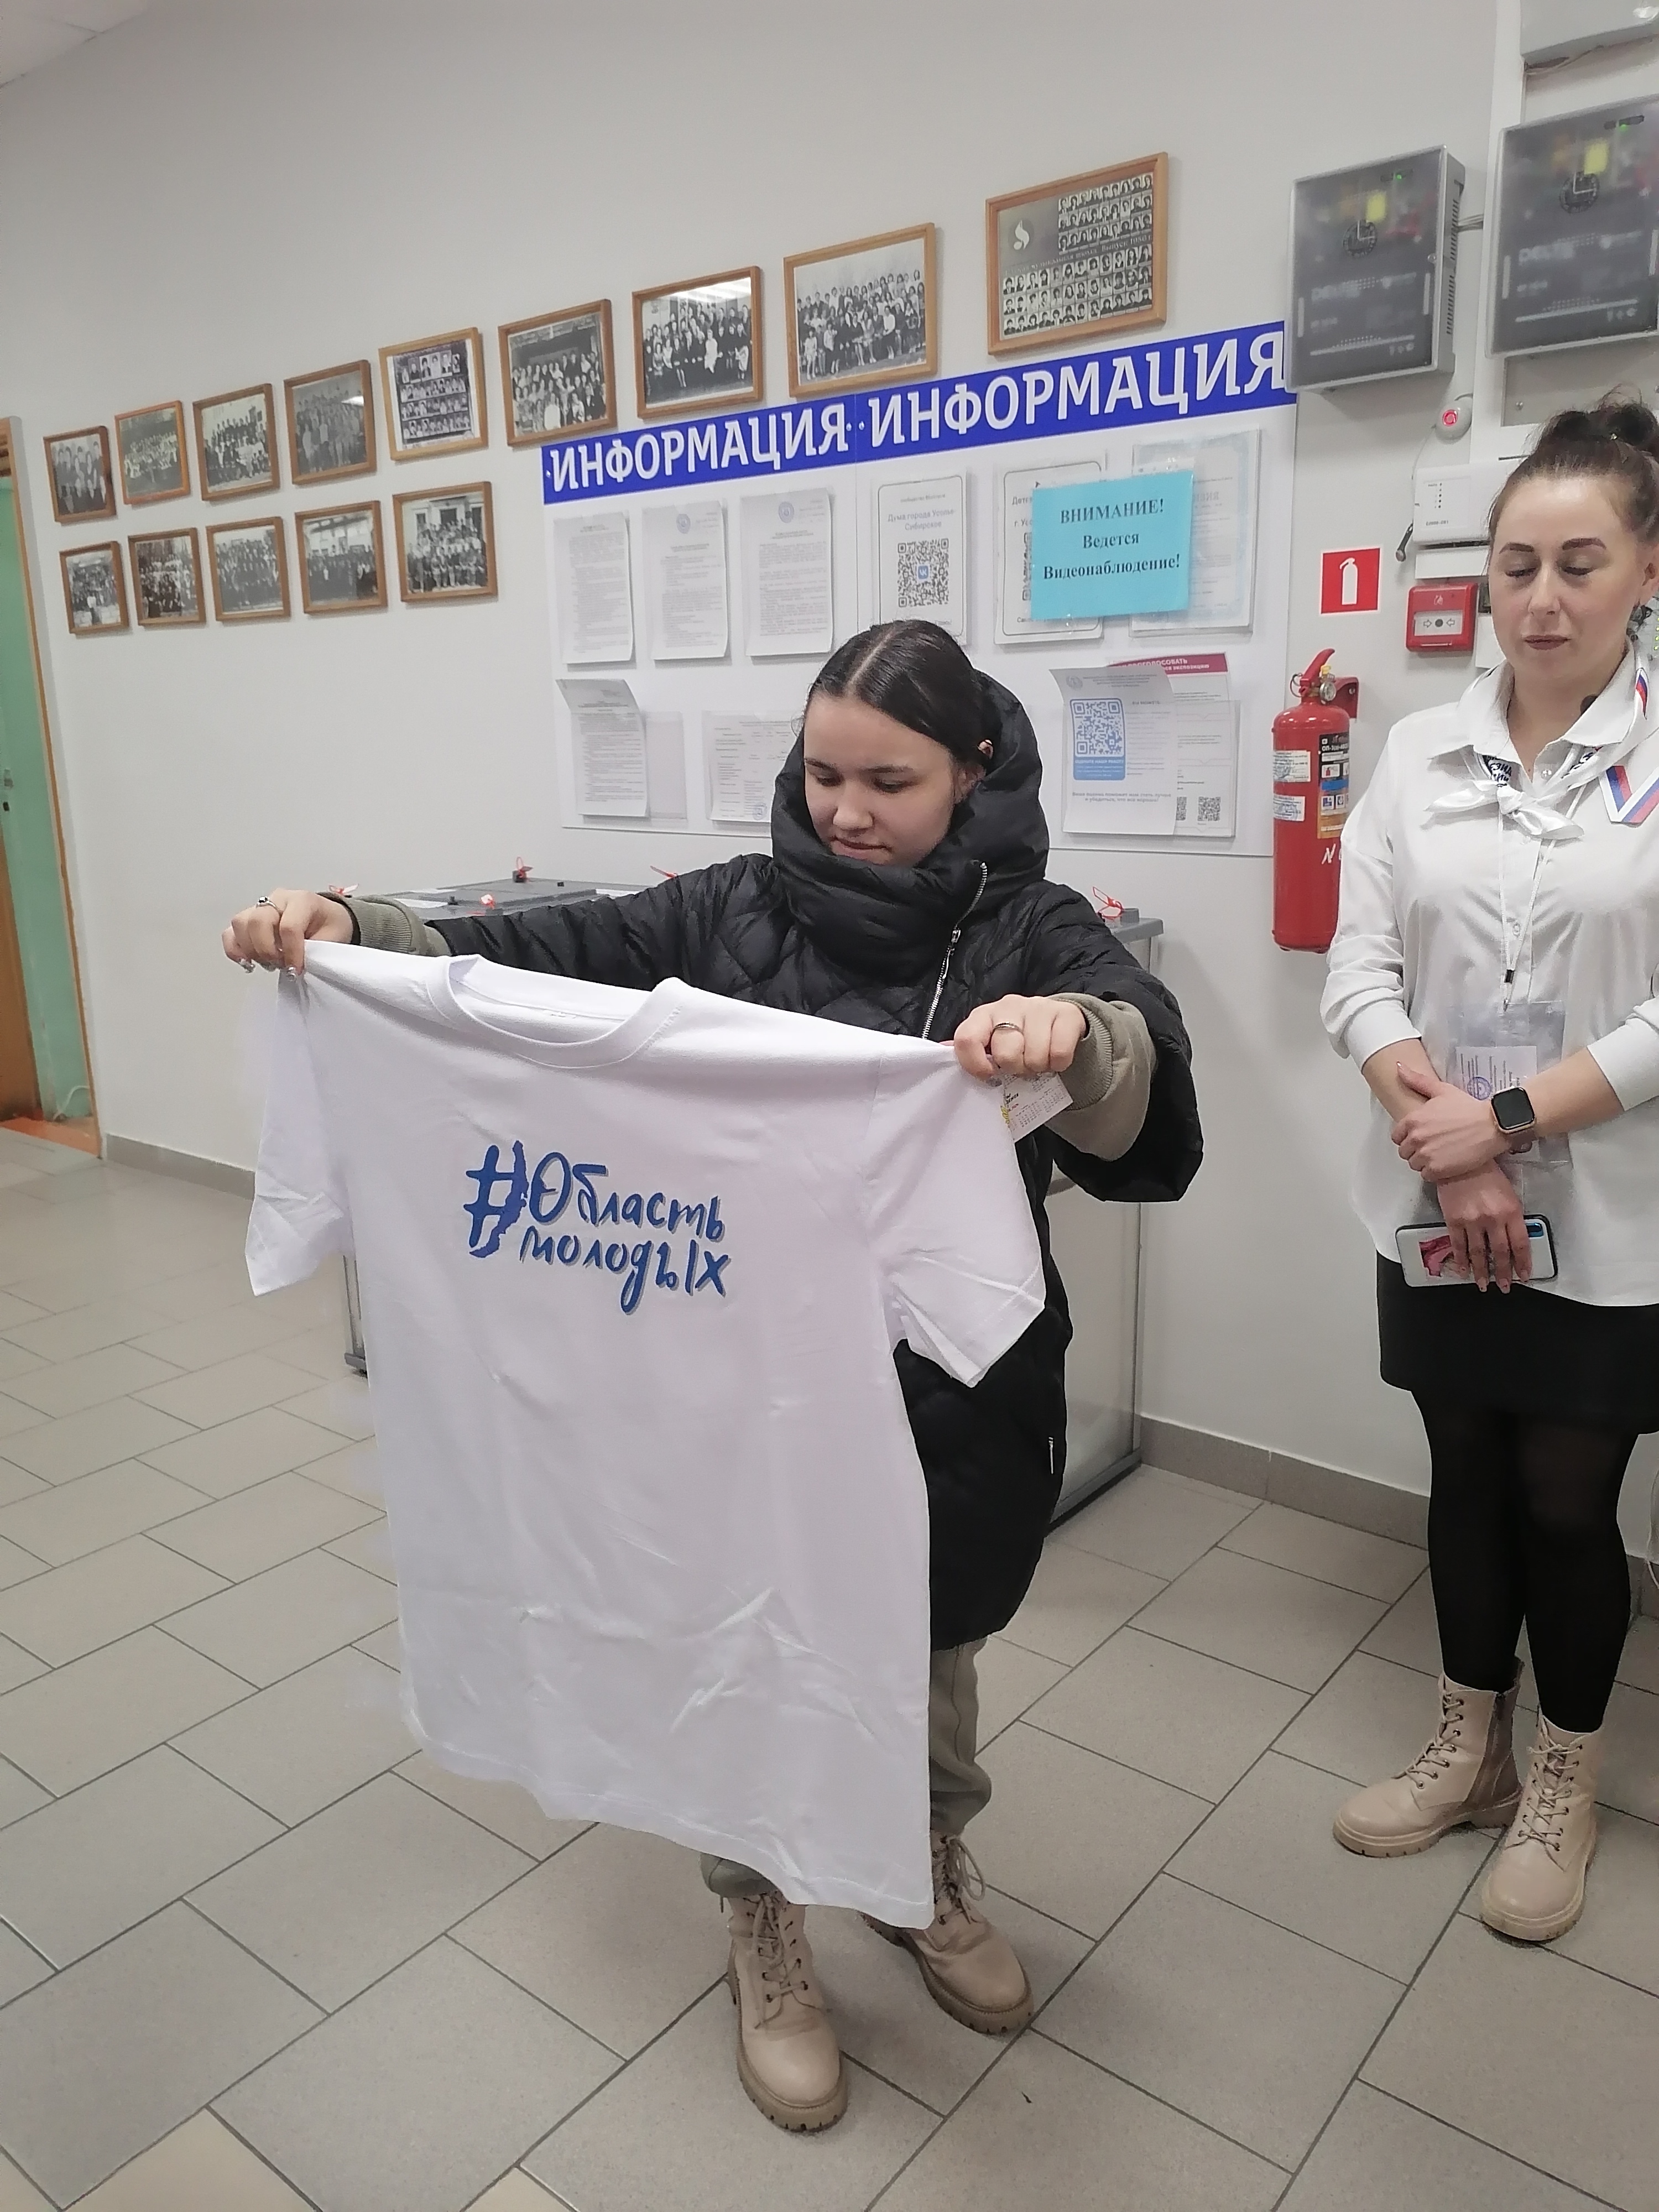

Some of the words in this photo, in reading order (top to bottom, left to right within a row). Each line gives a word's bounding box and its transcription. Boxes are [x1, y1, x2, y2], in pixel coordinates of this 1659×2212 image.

[868, 331, 1286, 447] ИНФОРМАЦИЯ
[550, 403, 849, 492] ИНФОРМАЦИЯ
[888, 514, 906, 522] Дума
[907, 512, 930, 520] города
[1060, 498, 1165, 524] ВНИМАНИЕ!
[905, 521, 942, 531] Сибирское
[1082, 533, 1140, 549] Ведется
[1043, 554, 1181, 580] Видеонаблюдение!
[463, 1140, 726, 1259] #Область
[520, 1225, 732, 1315] молодых
